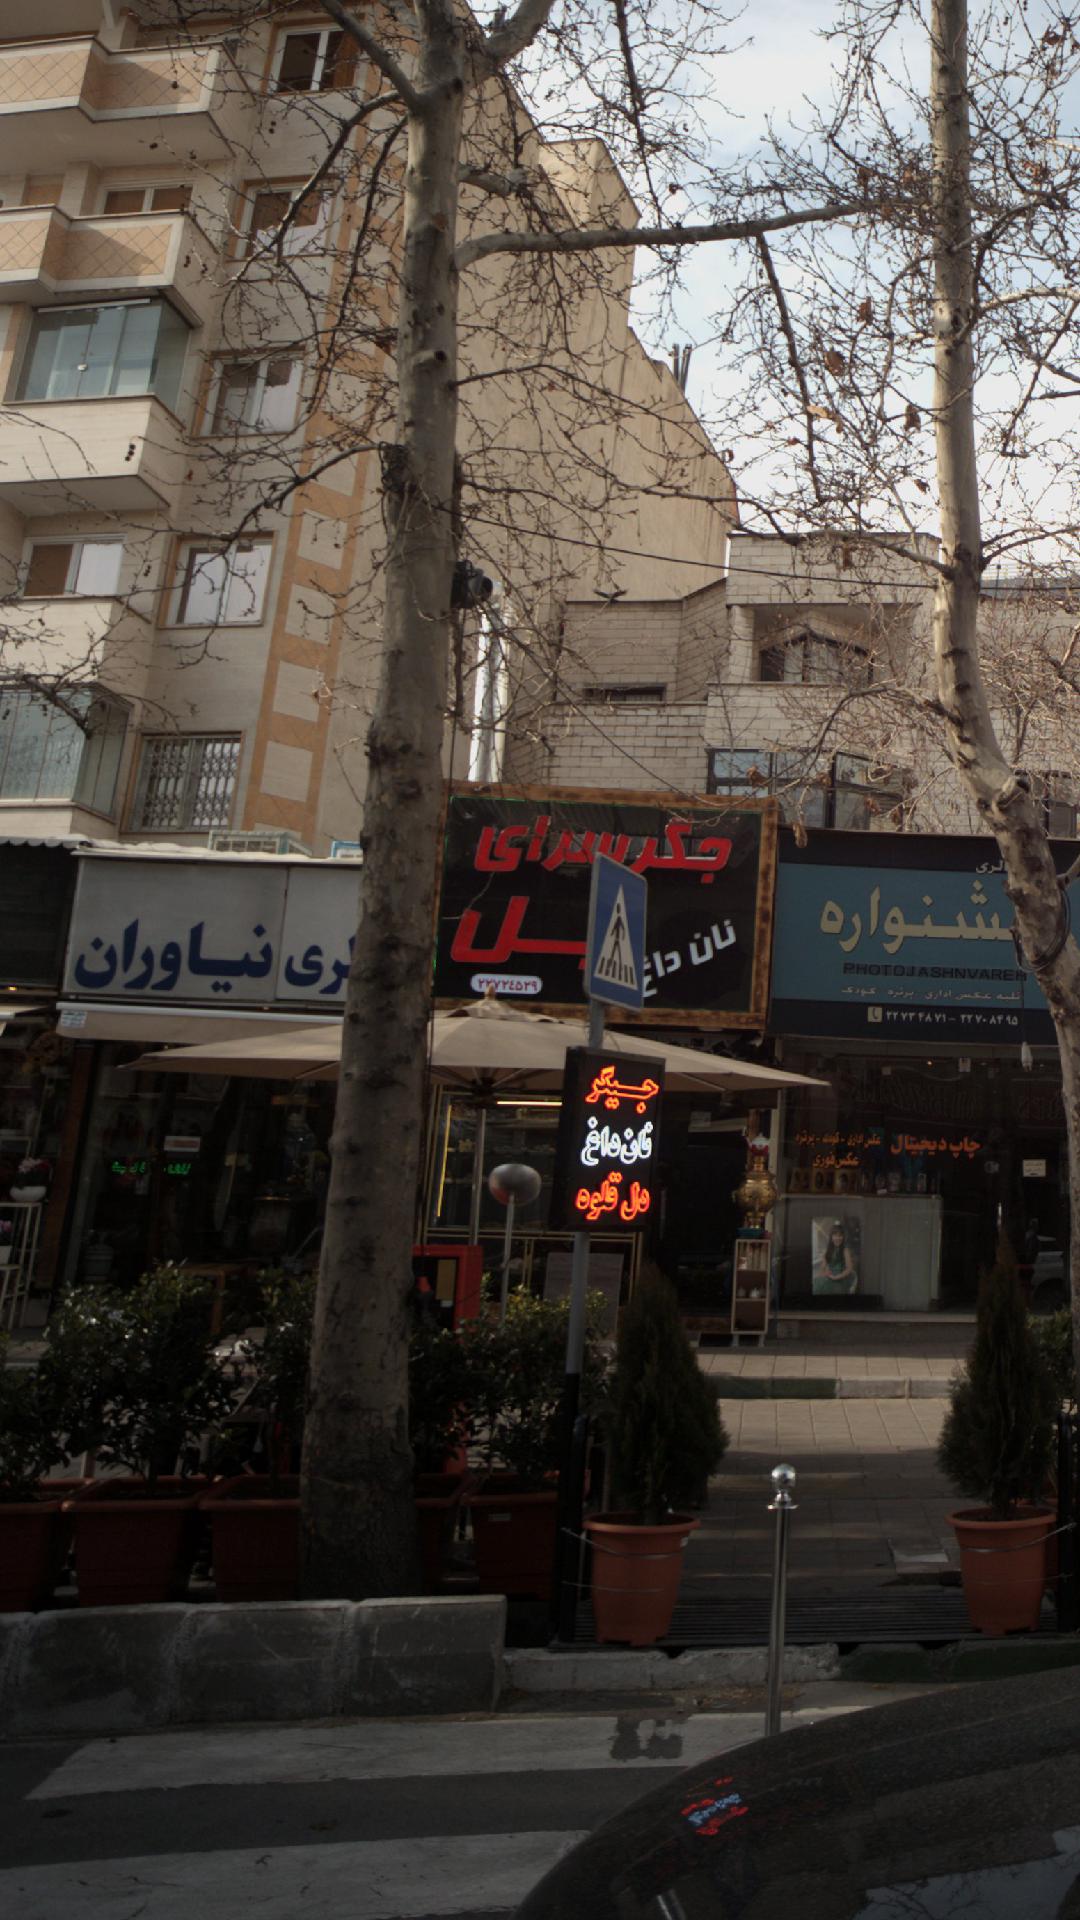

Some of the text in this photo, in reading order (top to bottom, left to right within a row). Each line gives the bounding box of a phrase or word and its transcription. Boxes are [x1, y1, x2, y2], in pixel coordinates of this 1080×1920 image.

[689, 919, 736, 965] نان
[820, 879, 1016, 954] شنواره
[74, 919, 273, 993] نیاوران
[580, 1116, 654, 1167] نان داغ
[890, 1134, 983, 1159] چاپ دیجیتال
[575, 1170, 651, 1222] دل قلوه
